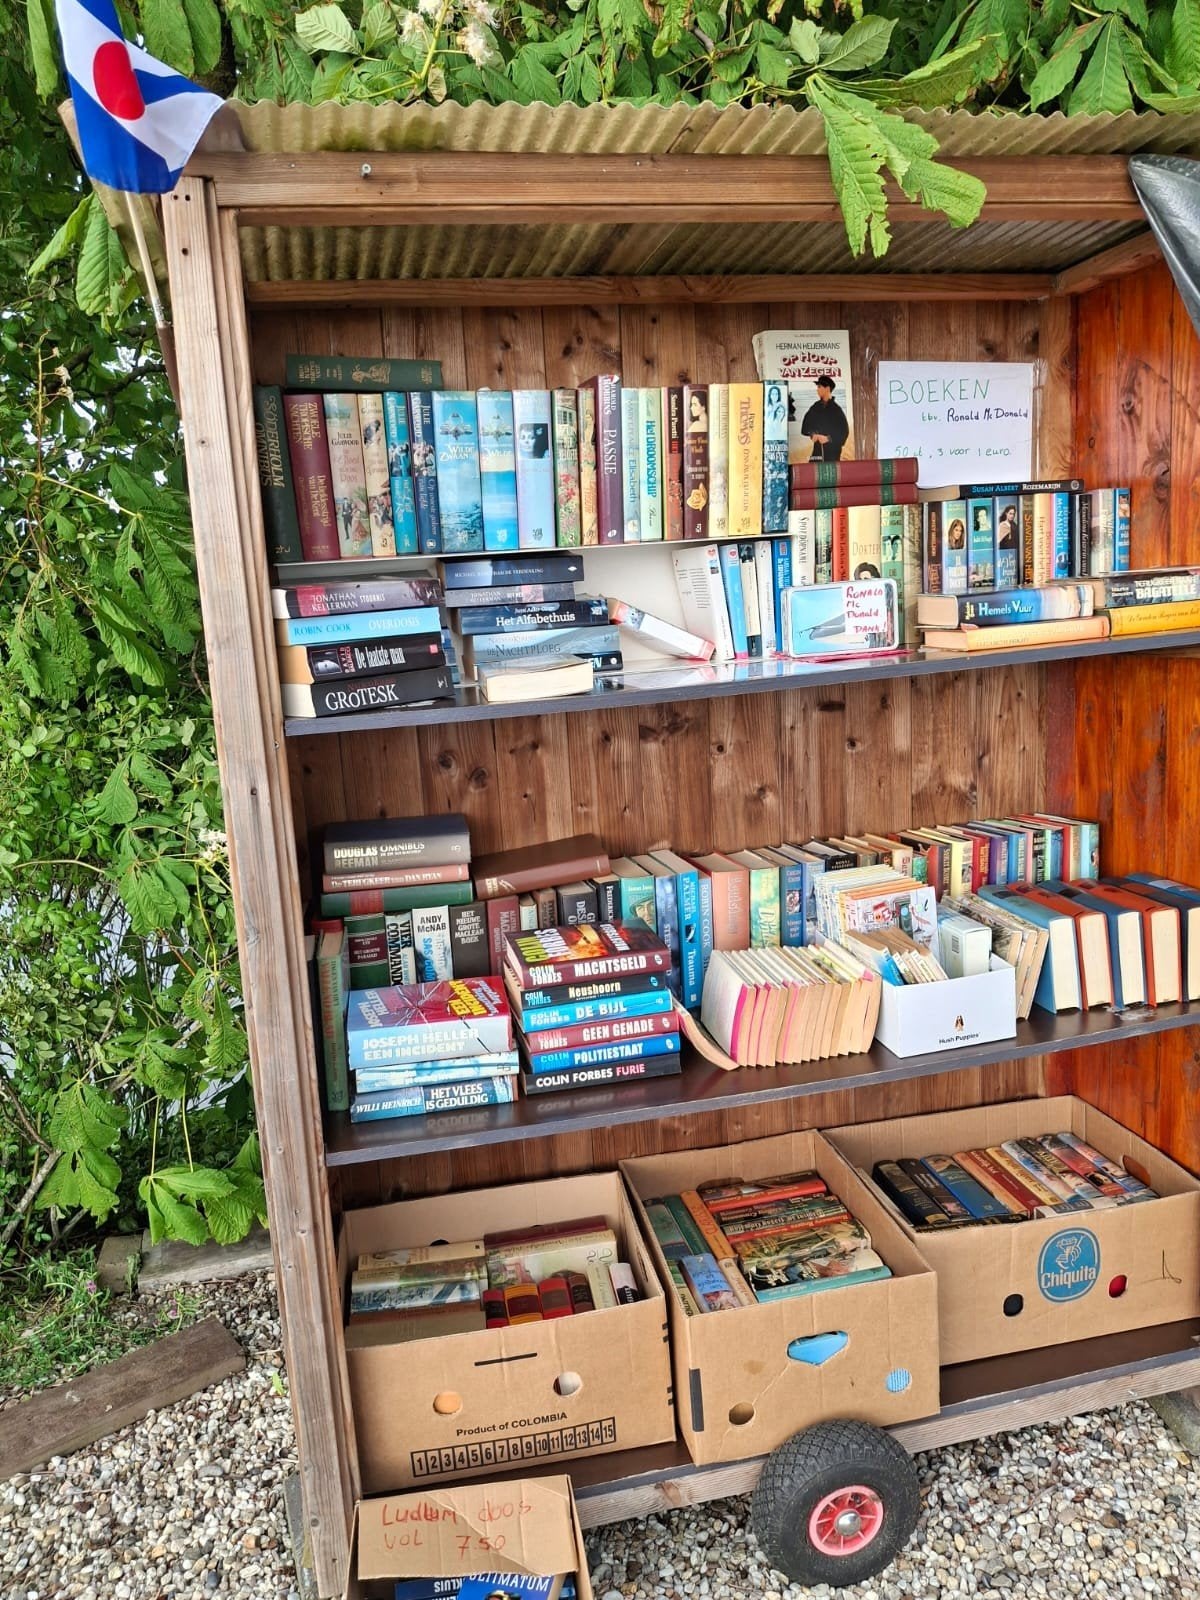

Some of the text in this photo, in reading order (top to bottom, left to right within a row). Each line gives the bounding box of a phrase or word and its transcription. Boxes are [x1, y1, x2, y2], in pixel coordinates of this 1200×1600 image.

[776, 342, 801, 350] HERMAN
[782, 351, 838, 366] OP HOOP
[778, 367, 842, 378] VAN ZEGEN
[603, 379, 612, 416] ROBBINS
[888, 378, 991, 406] BOEKEN
[289, 403, 302, 444] NACHTEN
[307, 402, 321, 439] ZWOELE
[422, 405, 432, 425] JULIE
[670, 394, 678, 439] Sandra Paretti
[738, 397, 751, 446] THOMAS
[946, 406, 980, 423] Ronald
[298, 402, 312, 450] TROPISCHE
[263, 395, 285, 489] SÖDERHOLM
[448, 444, 475, 454] WILDE
[603, 428, 617, 475] PASSIE
[894, 446, 909, 458] 50
[937, 446, 944, 457] 3
[949, 446, 971, 457] voor
[255, 421, 272, 488] OMNIBUS
[645, 437, 657, 498] DROOMSCHIP
[628, 459, 637, 503] Elisabeth
[971, 485, 993, 494] SUSAN
[995, 484, 1019, 492] ALBERT
[1024, 513, 1033, 544] SLAVIN
[1056, 497, 1064, 550] McNAUGHT
[1024, 545, 1033, 563] VAN
[311, 592, 356, 605] JONATHAN
[1135, 583, 1197, 600] BAGATELLE
[311, 600, 359, 612] KELLERMAN
[846, 600, 861, 609] Mc
[847, 609, 879, 618] Donald
[978, 602, 1012, 617] Hemels
[1012, 600, 1033, 613] Vuur
[294, 615, 420, 637] ROBIN COOK OVERDOSIS
[496, 612, 576, 626] Het Alfabethuis
[354, 645, 406, 669] De laatste man
[495, 643, 561, 657] NACHTPLOEG
[325, 683, 399, 711] GROTESK
[333, 847, 378, 859] DOUGLAS
[379, 842, 426, 852] OMNIBUS
[334, 856, 380, 868] REEMAN
[342, 876, 390, 888] TERUGKEER
[682, 877, 691, 921] PALMER
[420, 914, 442, 924] ANDY
[456, 916, 481, 925] NIEUWE
[461, 910, 475, 918] HET
[701, 884, 711, 948] ROBIN COOK
[400, 919, 412, 950] VIER
[417, 922, 447, 934] McNAB
[455, 928, 484, 940] MACLEAN
[457, 923, 480, 932] GROTE
[461, 936, 480, 944] BOEK
[515, 936, 548, 964] COLIN
[534, 928, 571, 958] FORBES
[529, 966, 554, 976] COLIN
[532, 955, 647, 986] FORBES MACHTSGELD
[687, 948, 696, 986] Trauma
[448, 980, 488, 1016] INCIDENT
[524, 992, 544, 1000] COLIN
[527, 982, 622, 1006] FORBES Neushoorn
[448, 999, 470, 1016] EEN
[530, 1002, 628, 1026] FORBES DE BIJL
[530, 1010, 560, 1020] COLIN
[362, 1028, 479, 1050] JOSEPH HELLER
[539, 1019, 654, 1050] FORBES GEEN GENADE
[938, 1032, 980, 1045] Hush Puppies
[364, 1041, 465, 1062] EEN INCIDENT
[540, 1052, 570, 1063] COLIN
[574, 1043, 644, 1064] POLITIESTAAT
[536, 1063, 646, 1088] COLIN FORBES FURIE
[426, 1094, 489, 1110] IS GEDULDIG
[430, 1084, 483, 1100] HET VLEES
[356, 1096, 422, 1114] WILLI HEINRICH
[1040, 1265, 1097, 1290] Chiquita
[456, 1411, 568, 1438] Product of COLOMBIA
[416, 1425, 614, 1471] 1 2 3 4 5 6 7 8 9 10 11 12 13 14 15
[456, 1534, 506, 1561] 7.50
